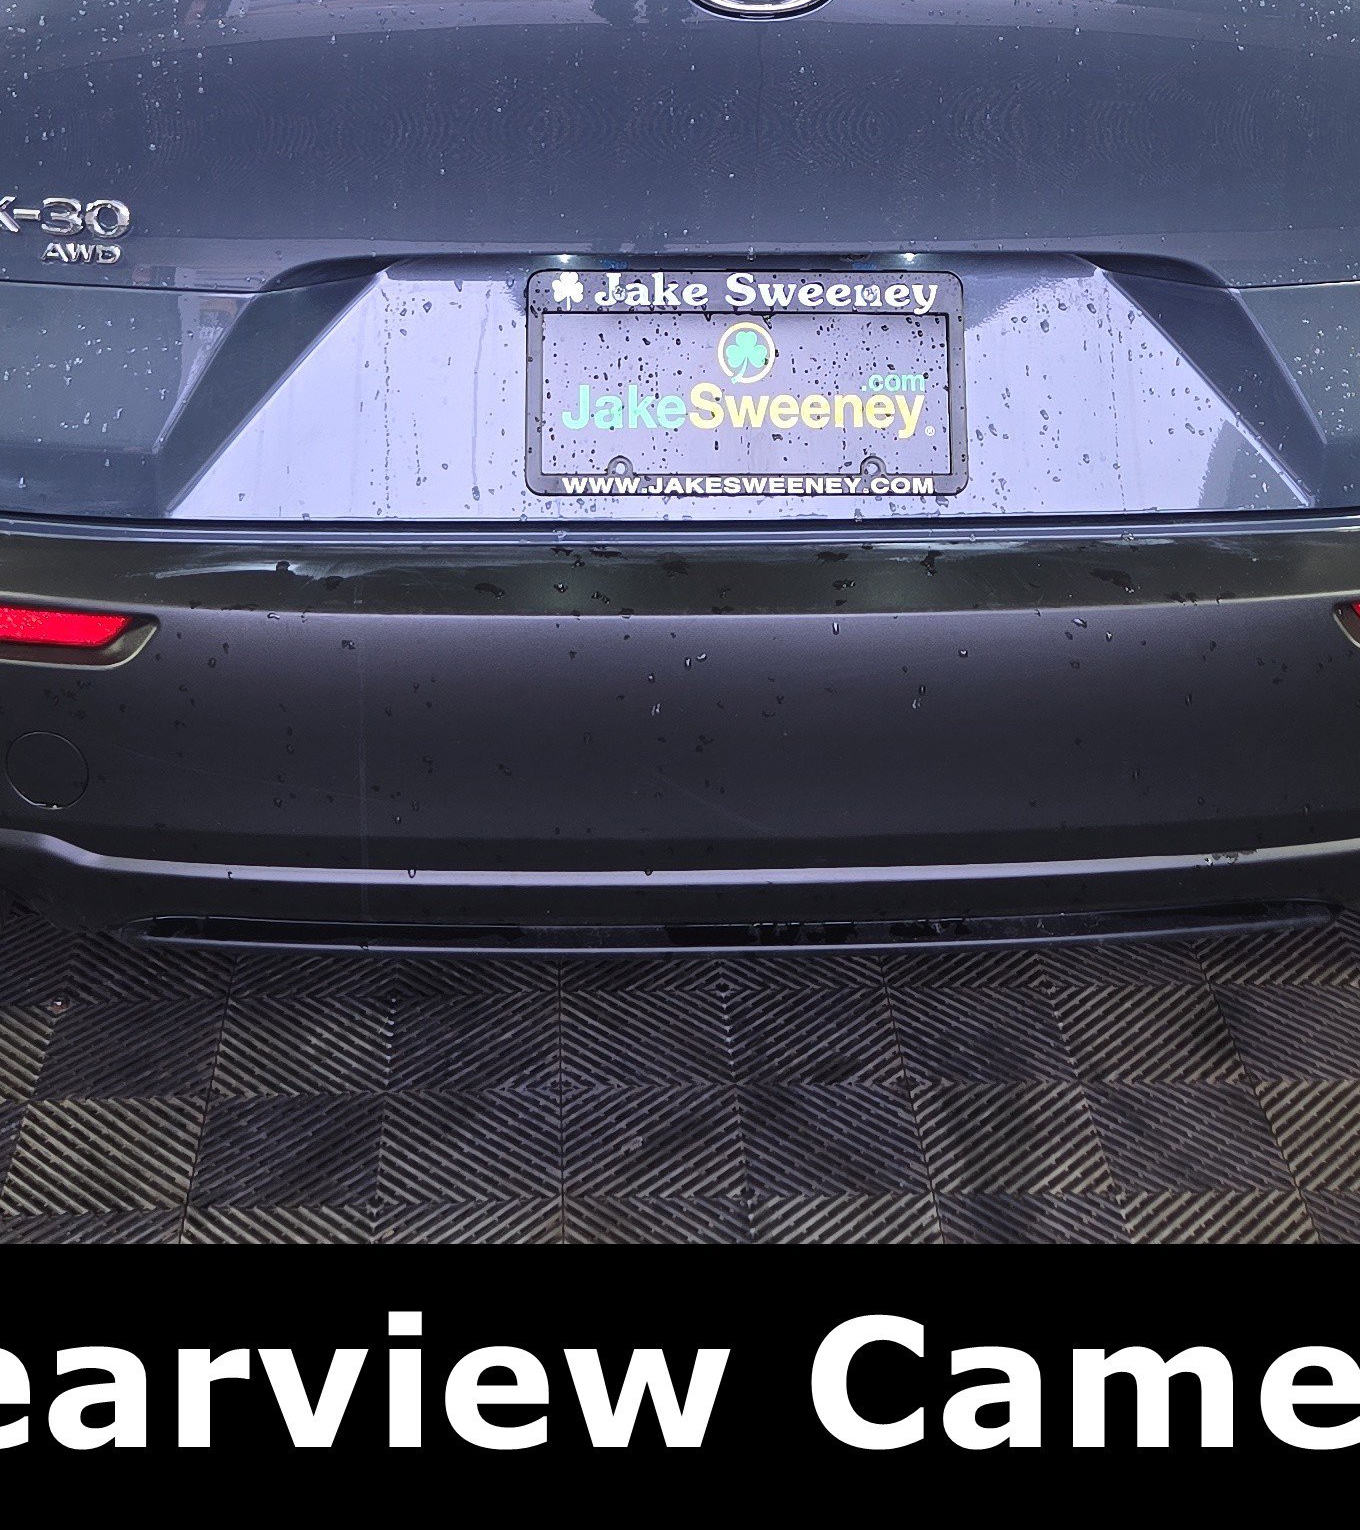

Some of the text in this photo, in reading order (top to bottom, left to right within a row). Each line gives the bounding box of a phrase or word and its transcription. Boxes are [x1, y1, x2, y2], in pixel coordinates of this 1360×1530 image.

[41, 242, 122, 265] AWD
[594, 272, 938, 314] Jake Sweeney
[562, 477, 934, 494] WWW.JAKESWEENEY.COM
